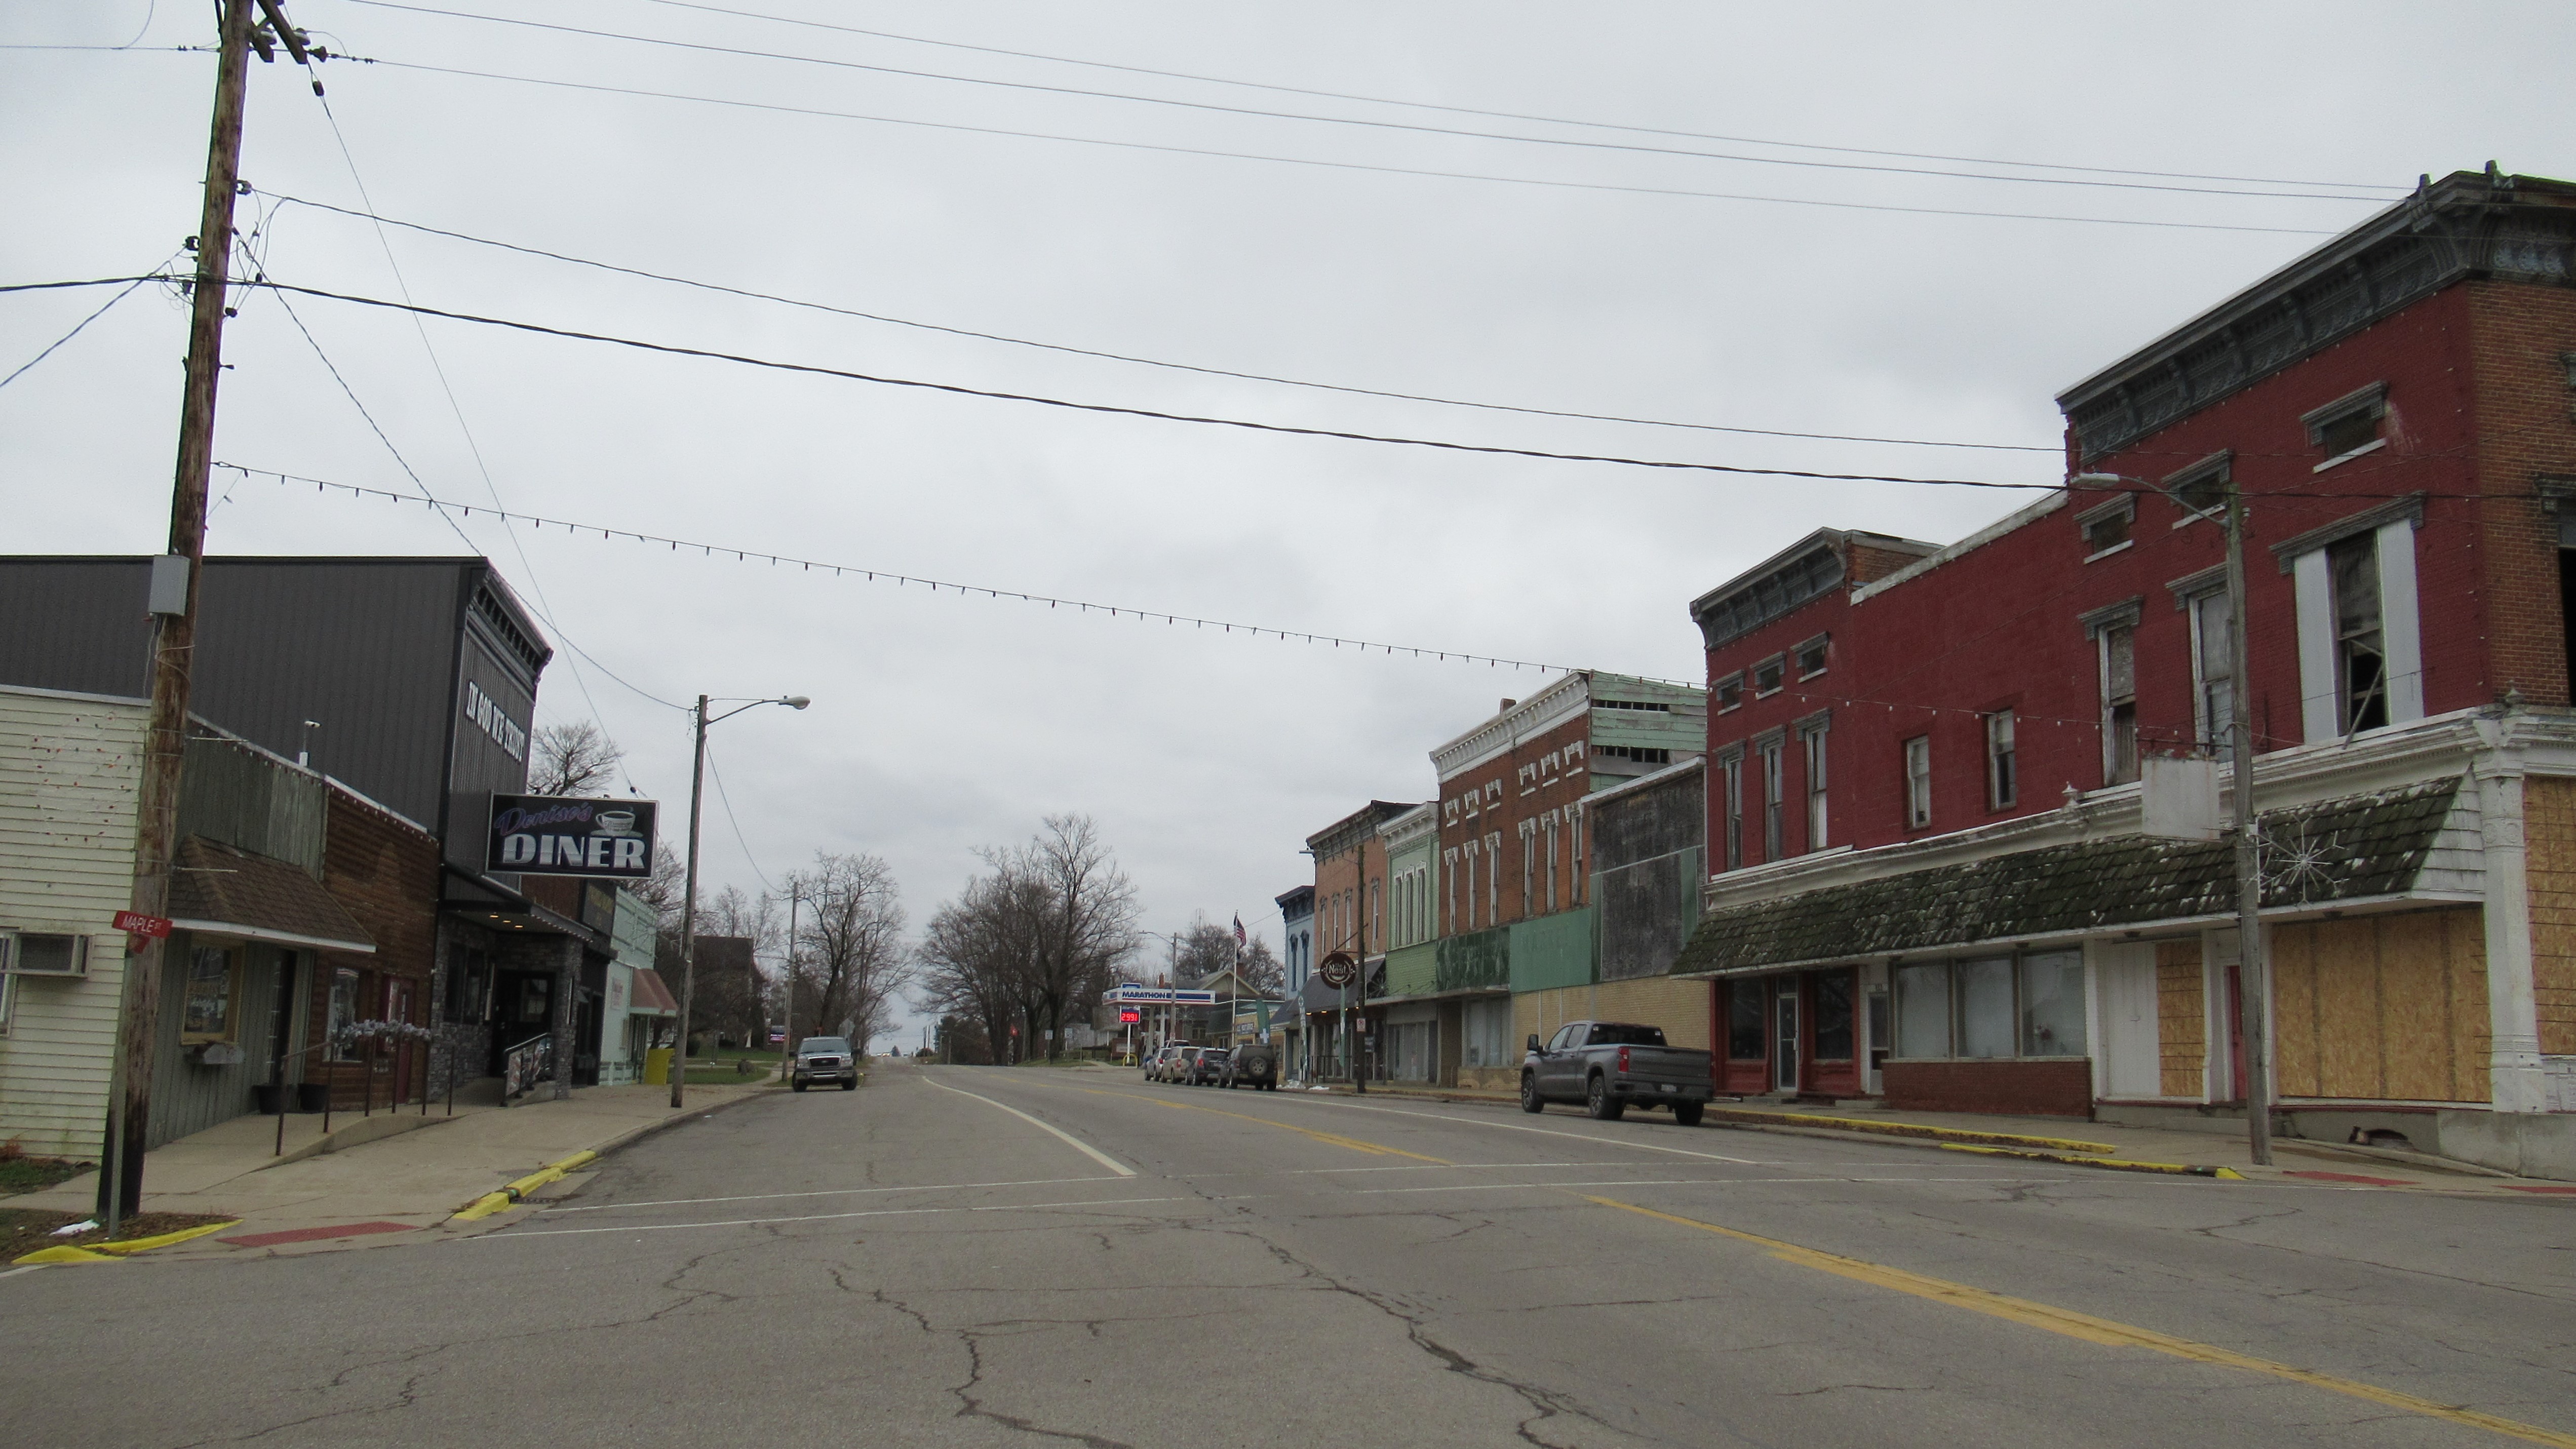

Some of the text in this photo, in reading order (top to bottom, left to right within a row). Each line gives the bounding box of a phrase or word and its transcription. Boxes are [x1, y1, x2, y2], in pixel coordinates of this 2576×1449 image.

[477, 692, 492, 733] GOD
[492, 705, 505, 744] WE
[504, 717, 525, 762] TRUST
[494, 802, 594, 835] Denise's
[503, 833, 645, 869] DINER
[122, 914, 155, 932] MAPLE
[1329, 963, 1346, 974] Nest
